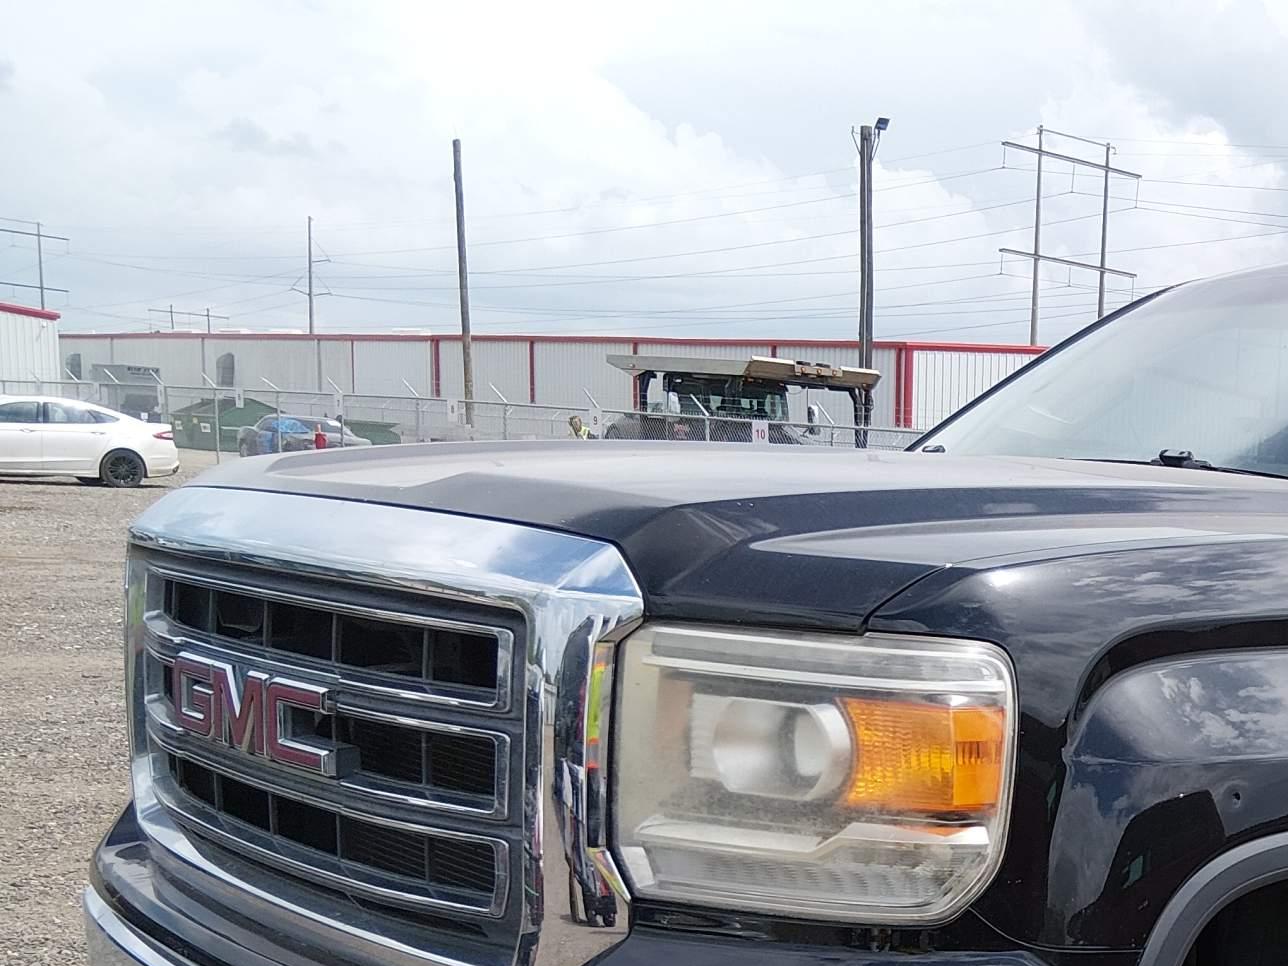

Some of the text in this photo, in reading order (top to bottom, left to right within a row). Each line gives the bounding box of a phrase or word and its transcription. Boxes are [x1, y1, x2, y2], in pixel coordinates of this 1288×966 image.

[593, 415, 599, 426] 9
[755, 429, 766, 440] 10
[174, 651, 337, 777] GMC
